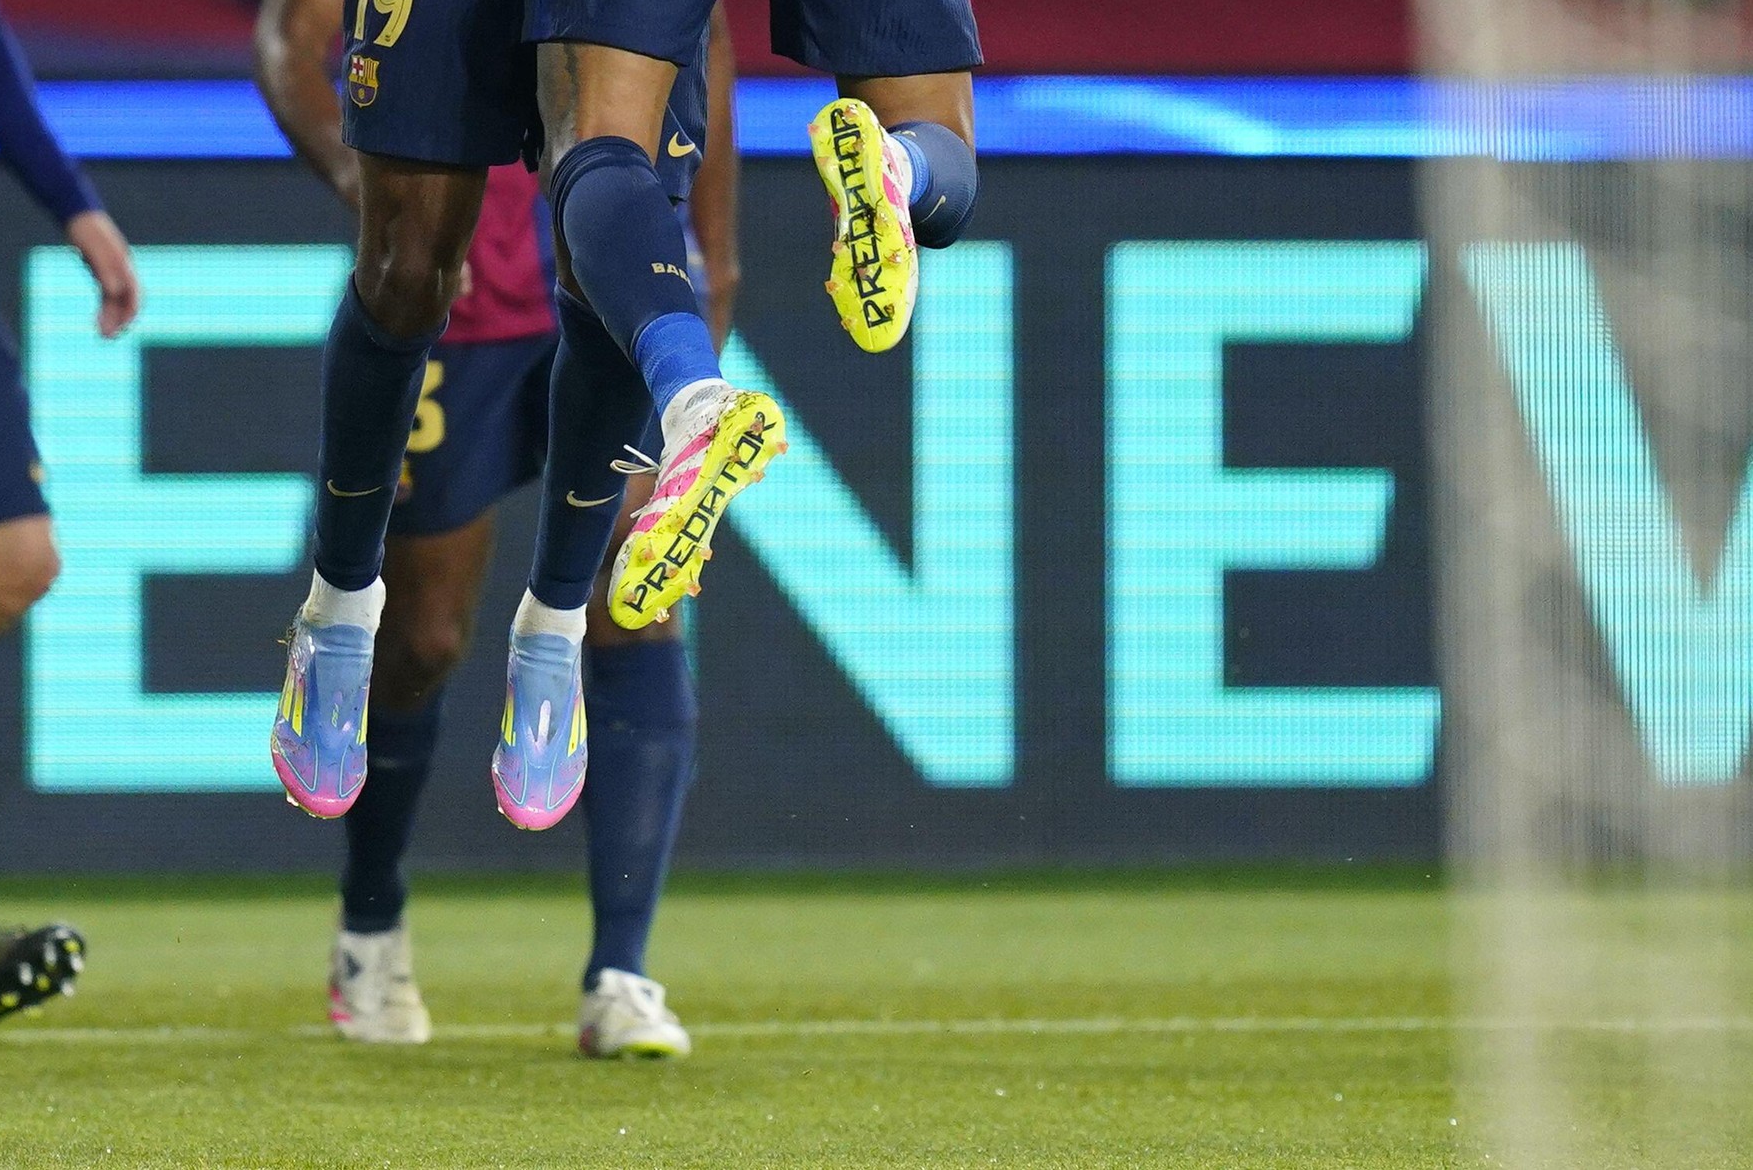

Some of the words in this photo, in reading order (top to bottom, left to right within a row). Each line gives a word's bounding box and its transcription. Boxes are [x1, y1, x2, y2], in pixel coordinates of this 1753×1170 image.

[651, 262, 694, 294] BAR
[830, 107, 891, 329] PREDATOR
[623, 411, 778, 615] PREDATOR
